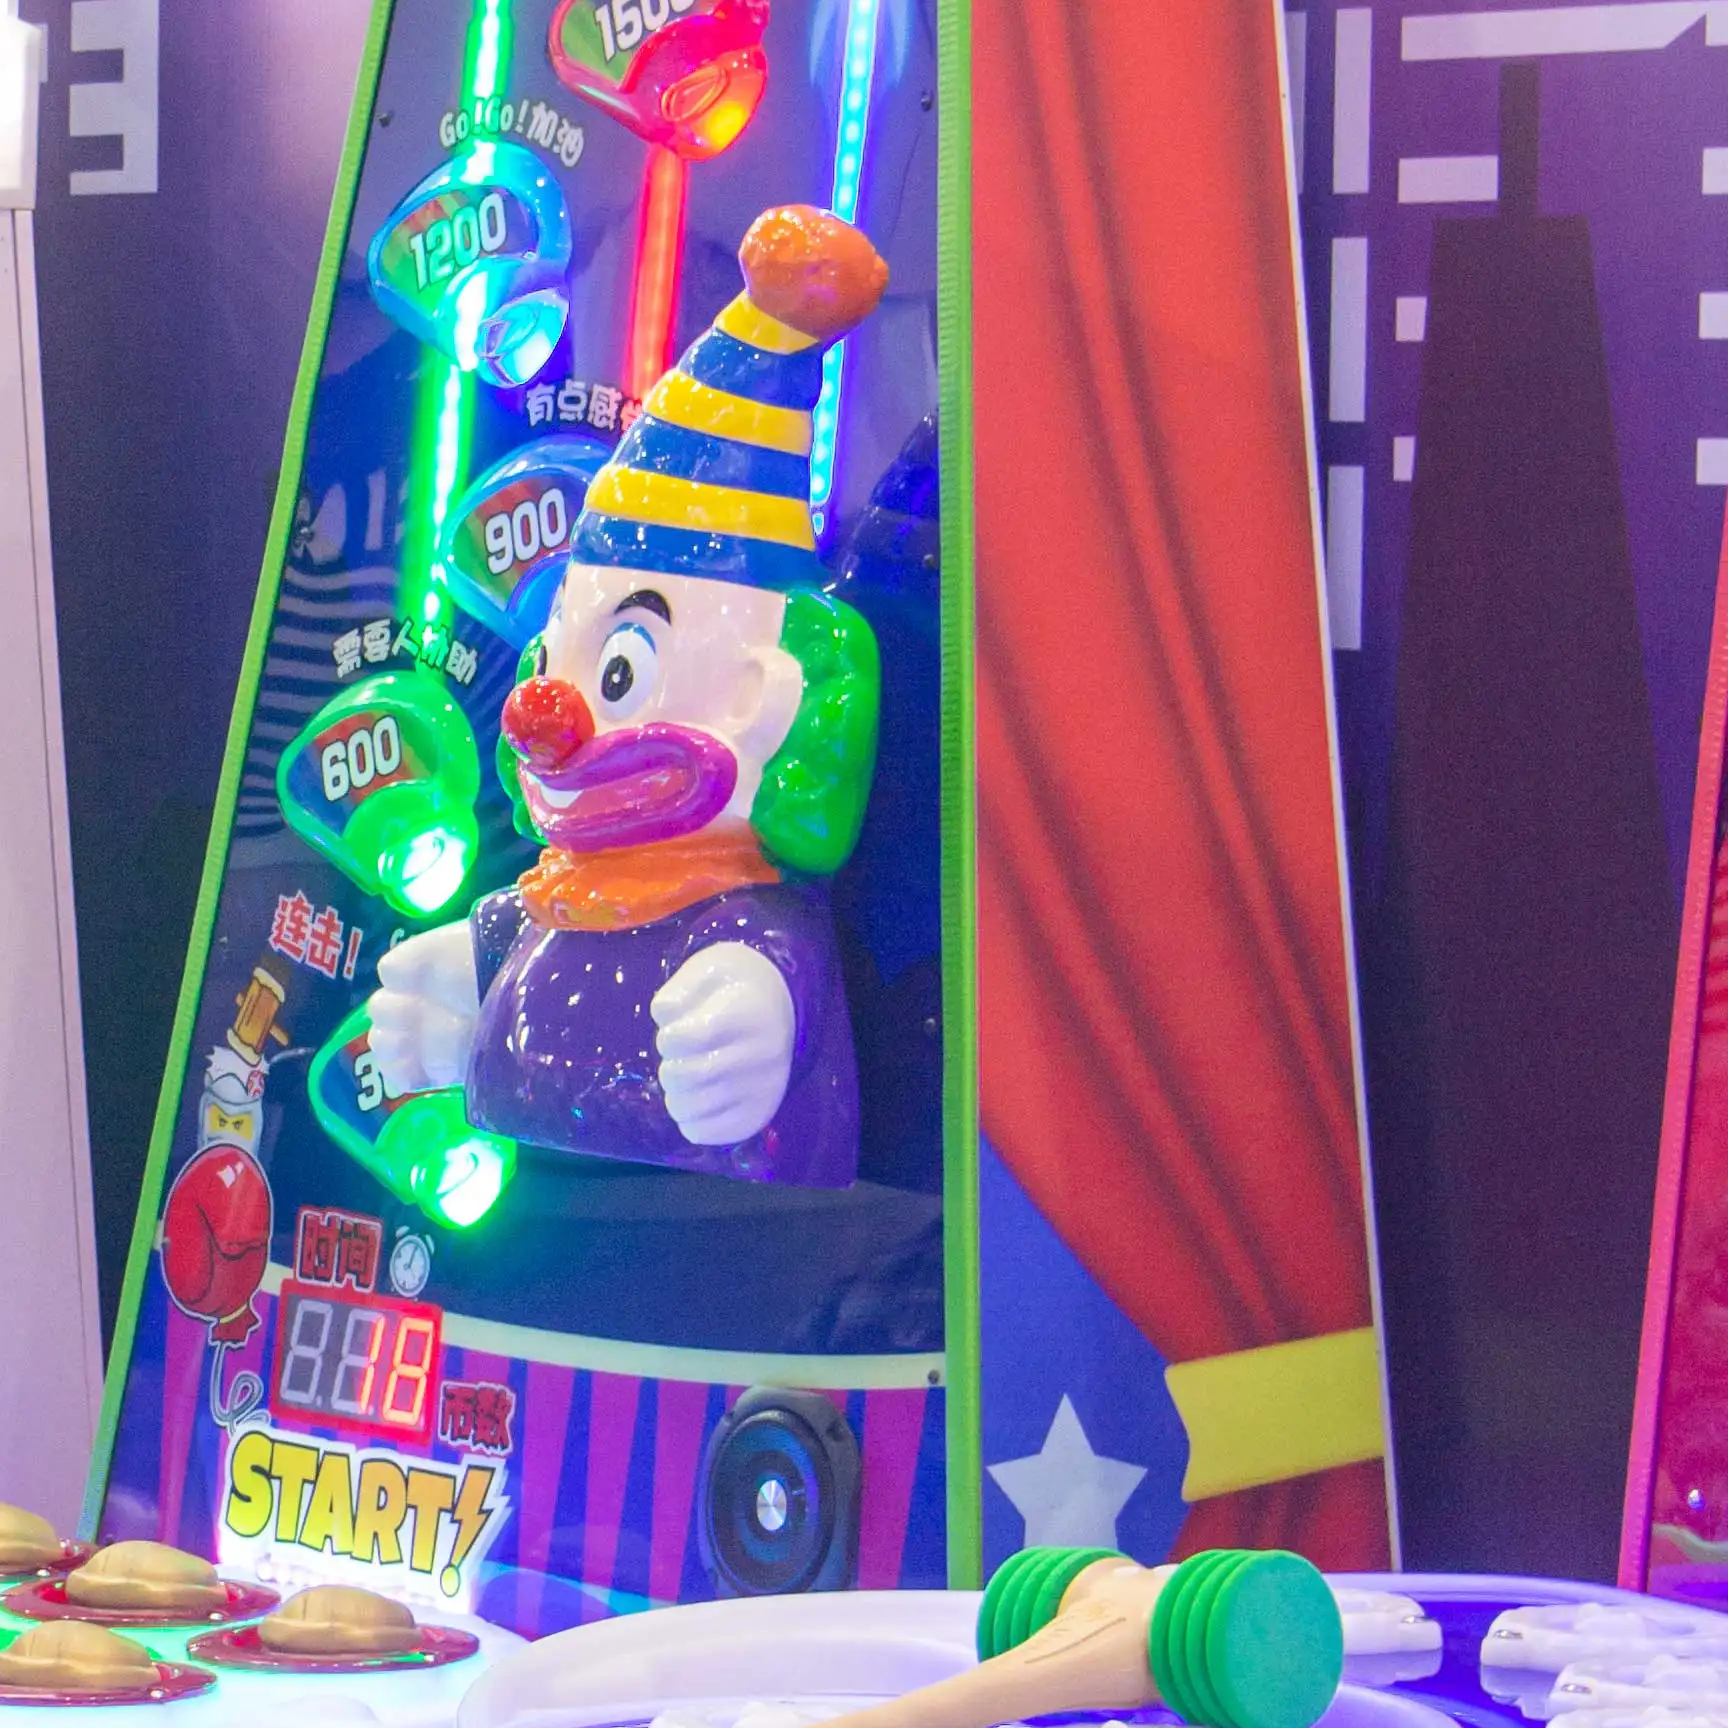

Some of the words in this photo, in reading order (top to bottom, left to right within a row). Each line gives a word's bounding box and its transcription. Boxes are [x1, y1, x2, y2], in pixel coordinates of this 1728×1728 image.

[408, 191, 508, 292] 1200
[483, 486, 567, 574] 900
[321, 714, 402, 803] 600
[297, 1210, 382, 1292] 时间
[225, 1430, 496, 1598] START!
